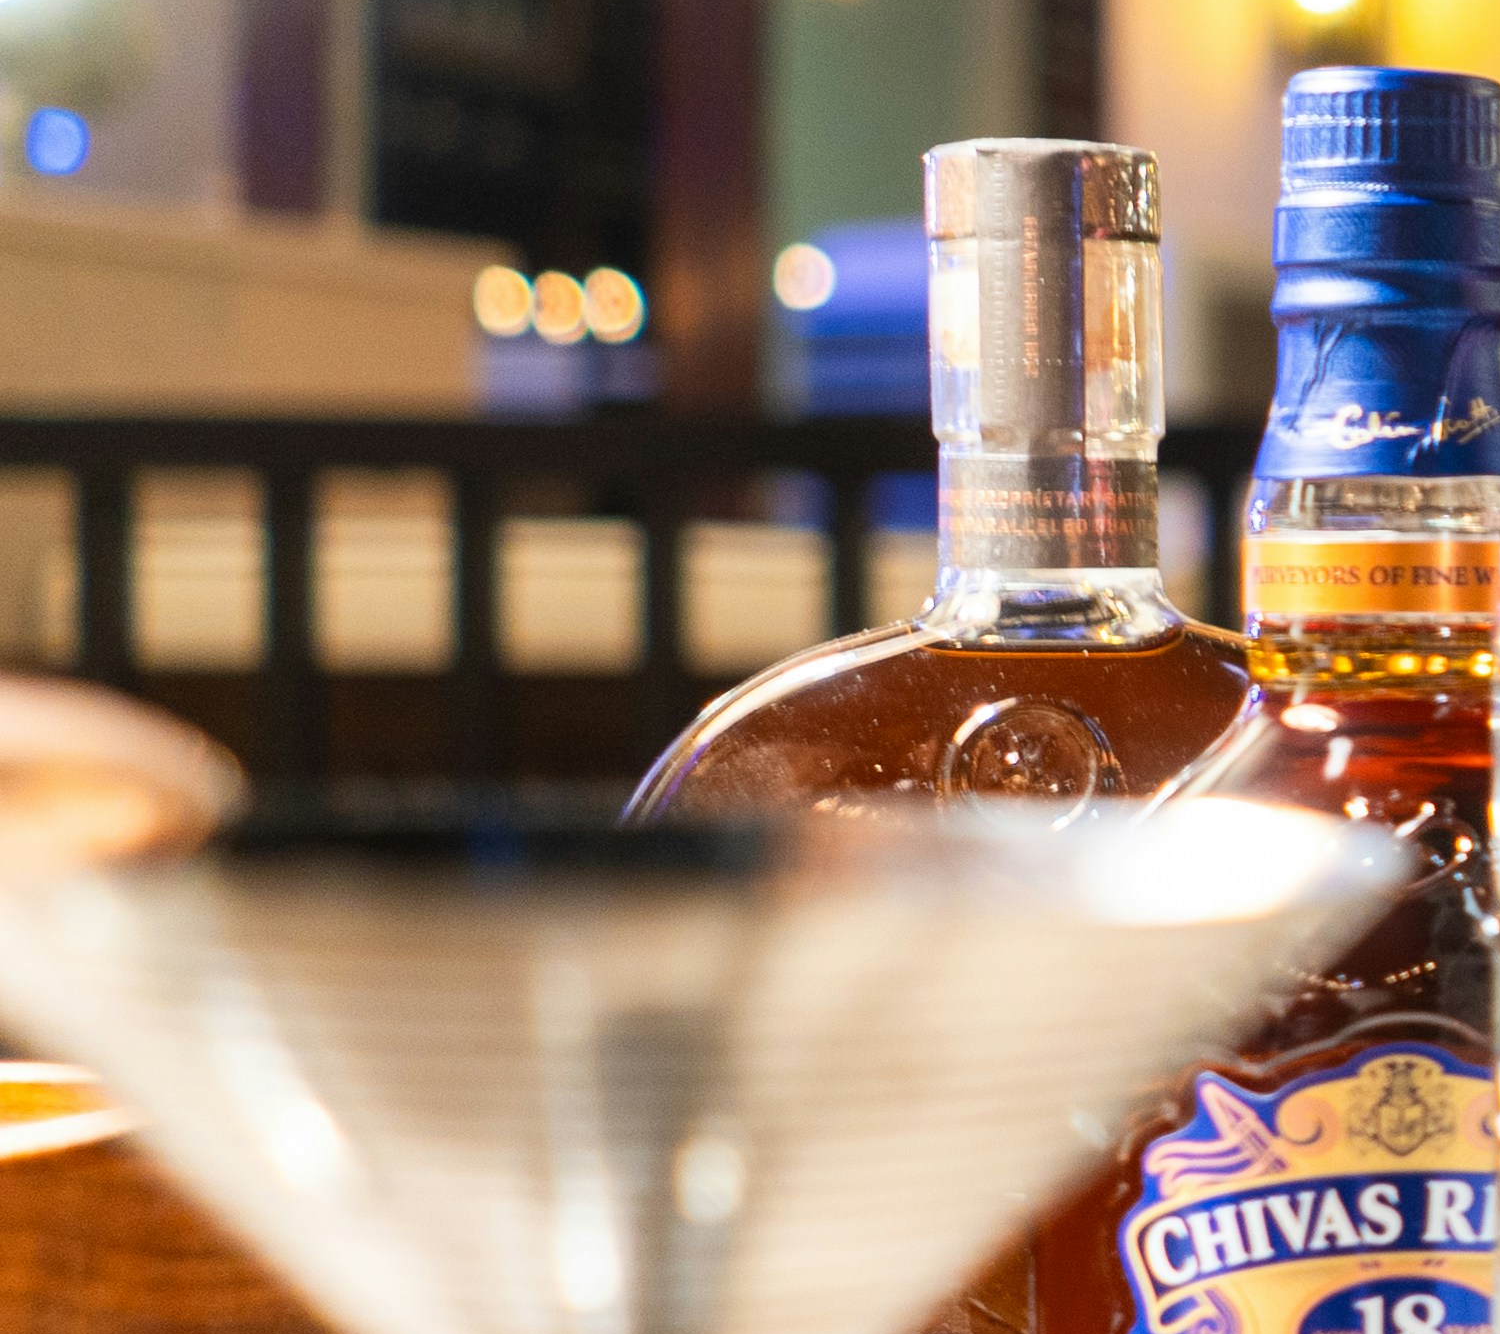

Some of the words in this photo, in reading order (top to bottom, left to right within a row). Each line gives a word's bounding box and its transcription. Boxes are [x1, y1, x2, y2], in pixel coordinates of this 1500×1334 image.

[1368, 565, 1404, 587] OF
[1412, 566, 1466, 587] FINE
[1144, 1182, 1404, 1287] CHIVAS
